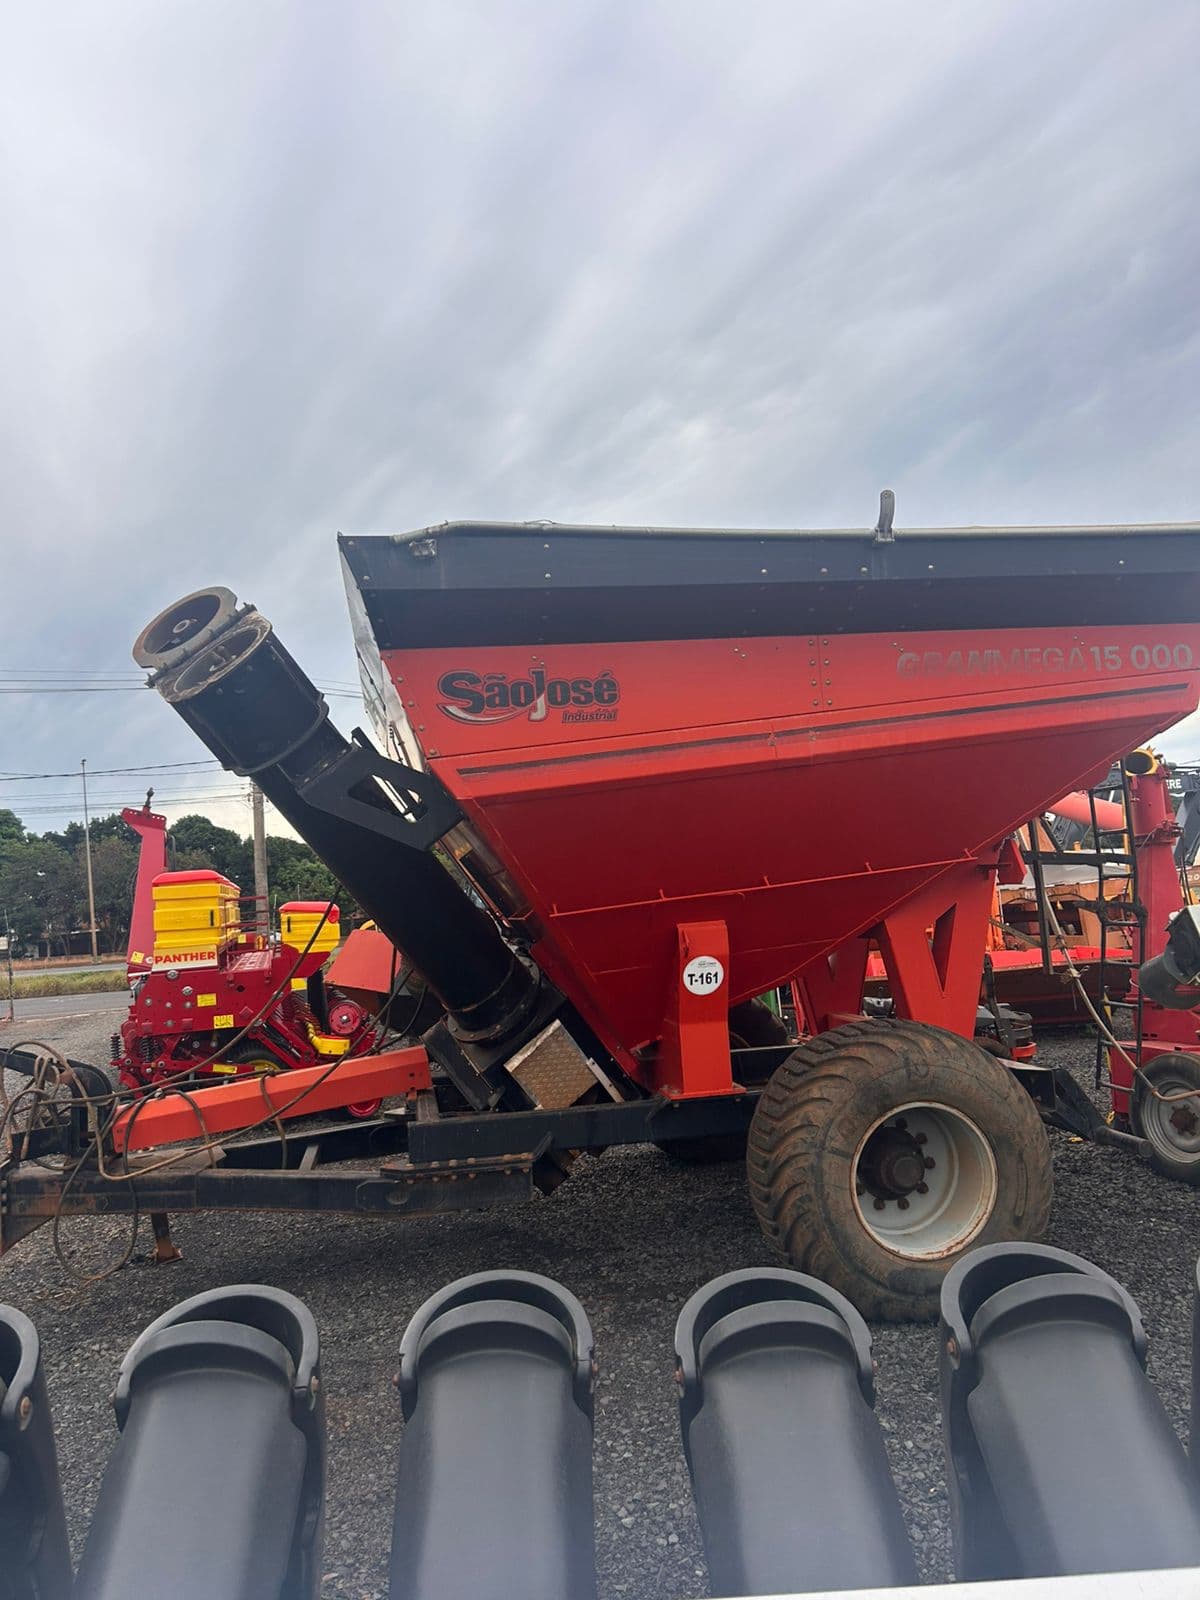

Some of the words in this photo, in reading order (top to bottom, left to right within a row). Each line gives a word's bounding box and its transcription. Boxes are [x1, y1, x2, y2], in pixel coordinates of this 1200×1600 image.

[1090, 646, 1122, 671] 15
[1130, 643, 1193, 670] 000
[563, 710, 617, 723] Industrial
[155, 951, 216, 964] PANTHER
[687, 971, 719, 986] T-161
